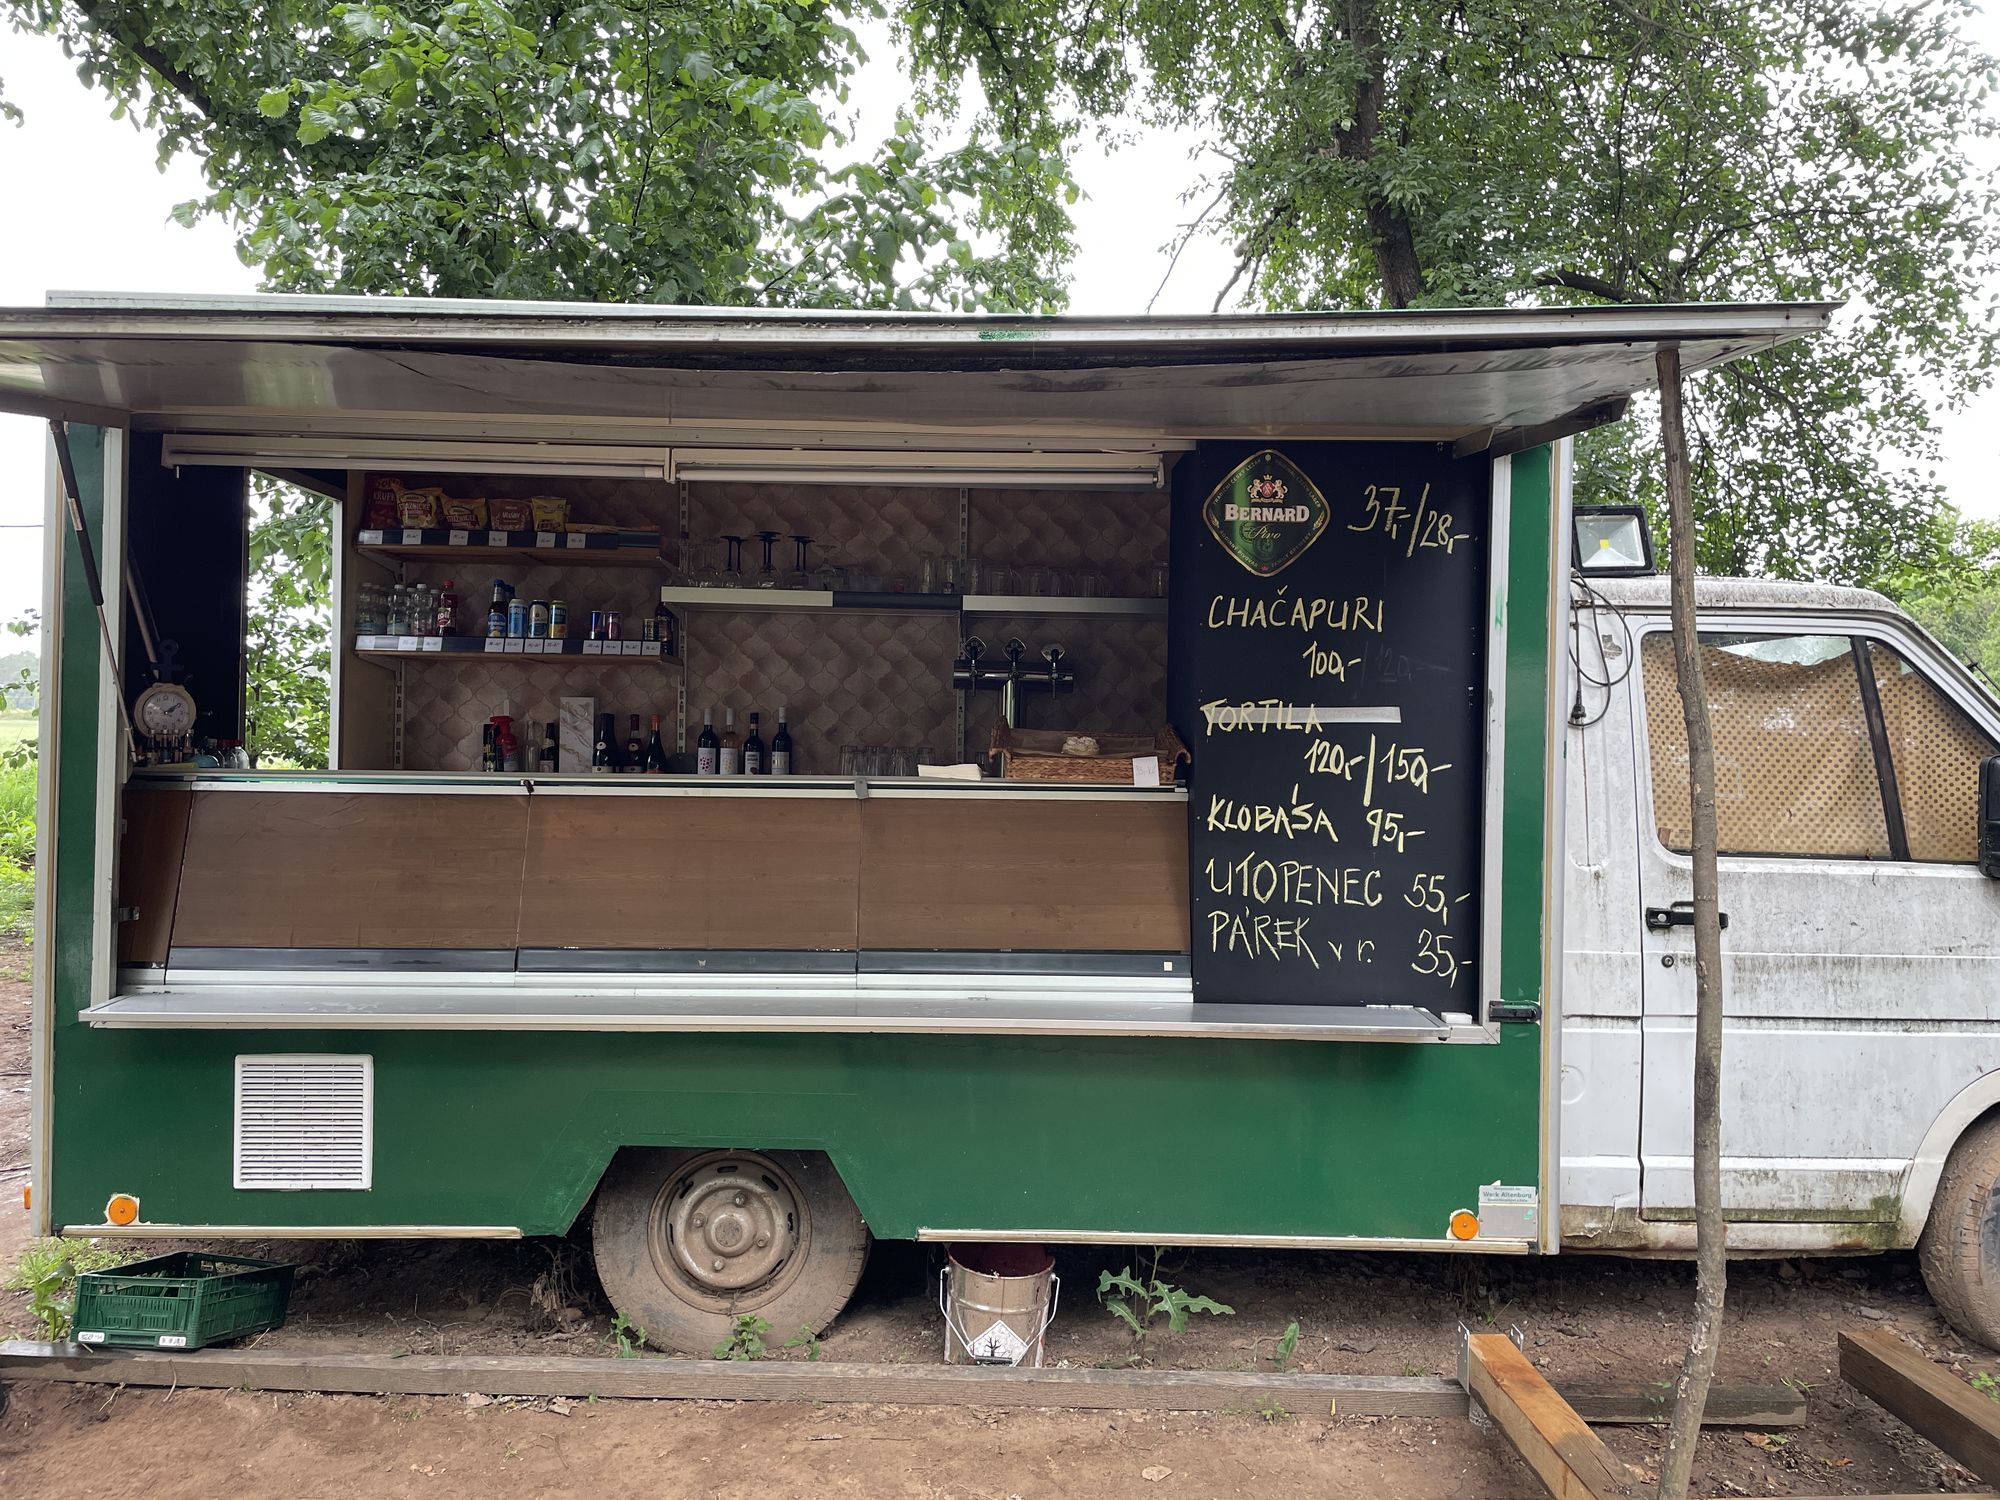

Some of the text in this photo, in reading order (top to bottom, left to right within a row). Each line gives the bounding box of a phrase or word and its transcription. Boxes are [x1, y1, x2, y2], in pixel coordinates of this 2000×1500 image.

[1224, 504, 1310, 523] BERNARD
[1246, 524, 1281, 542] Pivo
[1208, 585, 1384, 632] CHAČAPURI
[1200, 698, 1323, 736] TORTILA
[1366, 809, 1426, 853] 95,-
[1205, 851, 1471, 926] UTOPENEC 55,-
[1208, 906, 1320, 969] PÁREK
[1411, 928, 1472, 988] 35,-
[1501, 1191, 1532, 1199] Altenburg
